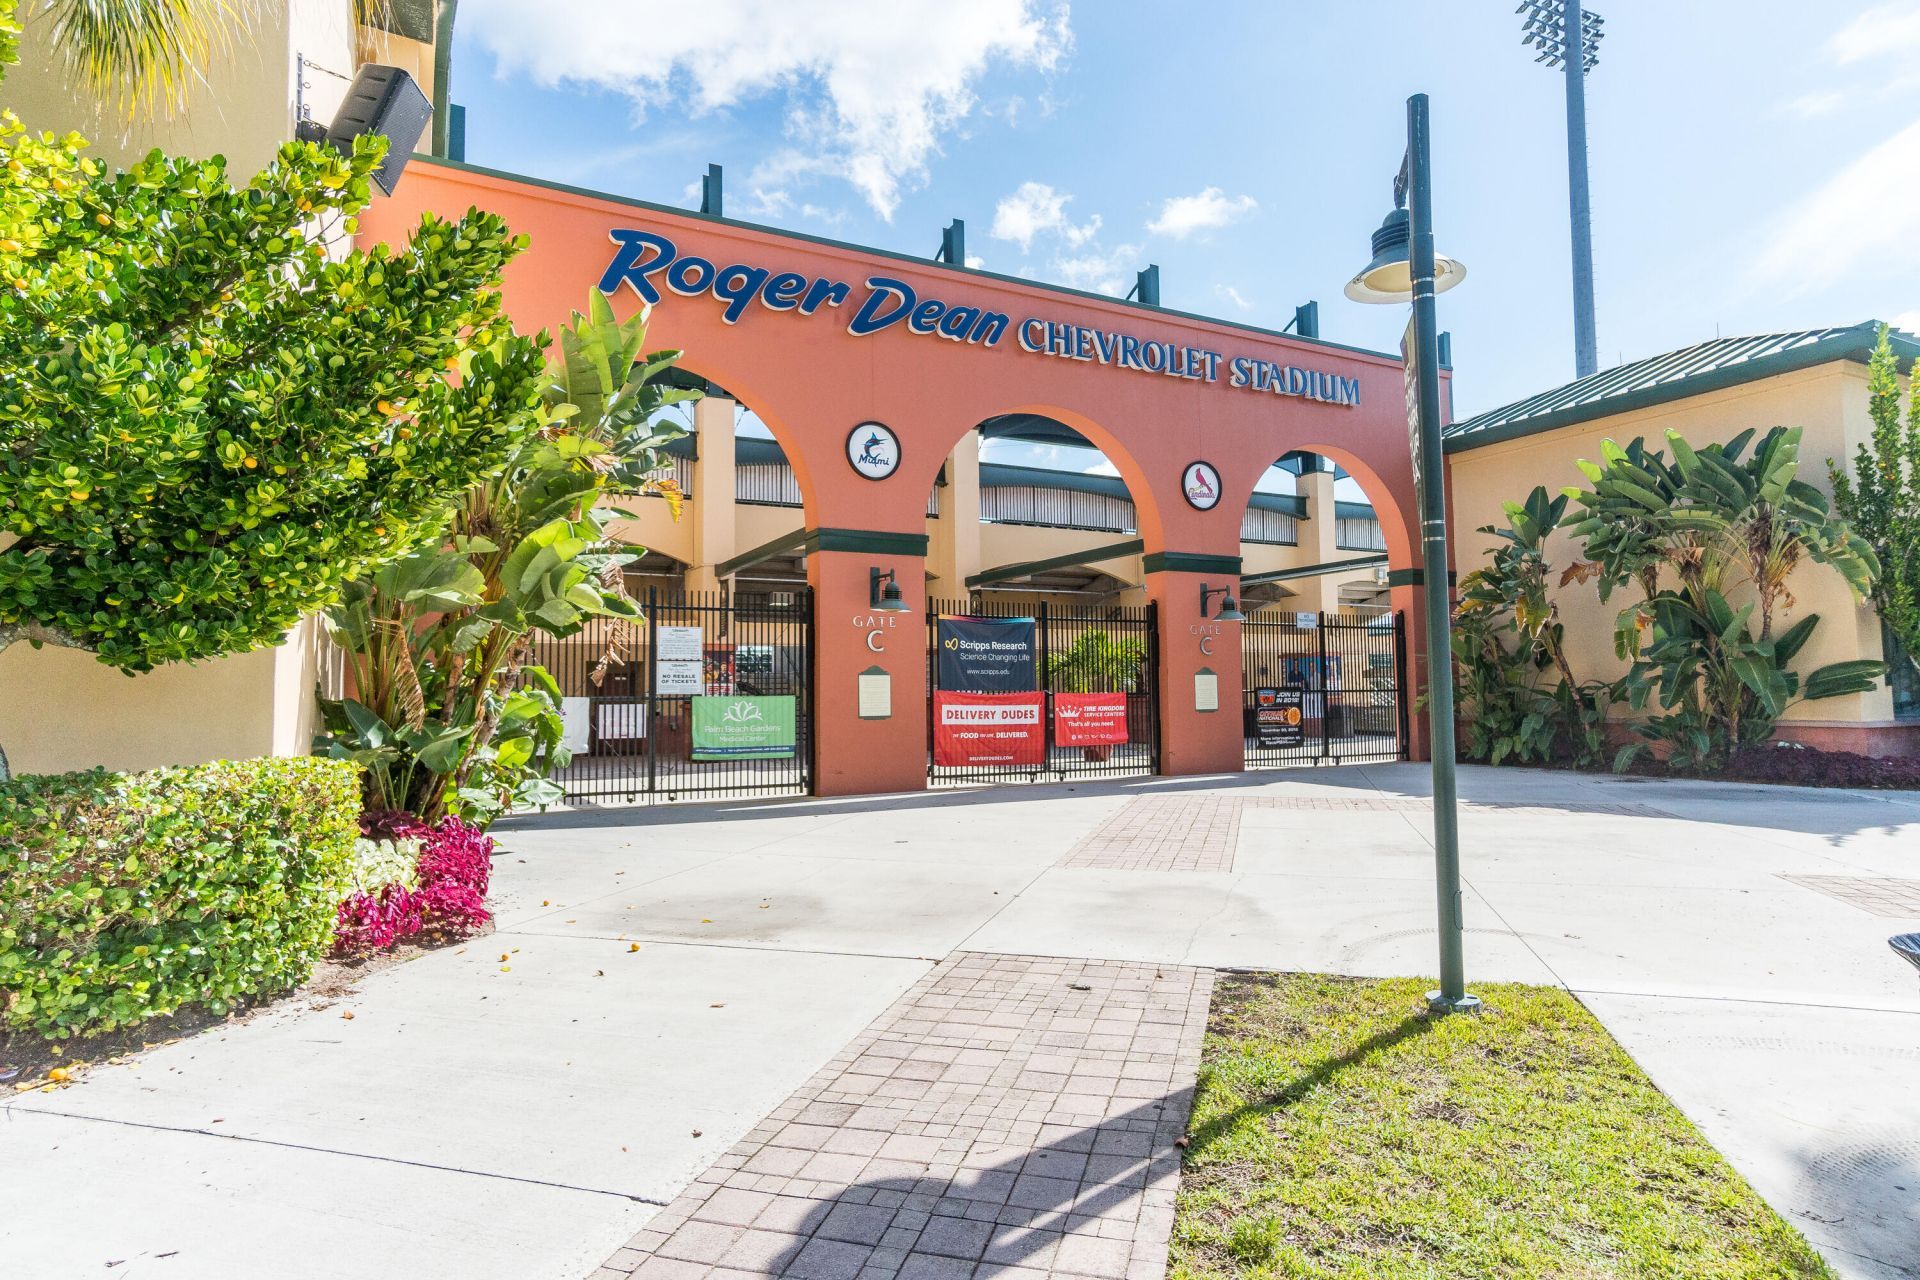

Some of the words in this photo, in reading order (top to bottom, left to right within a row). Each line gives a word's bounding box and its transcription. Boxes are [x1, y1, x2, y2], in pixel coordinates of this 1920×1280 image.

[599, 228, 852, 326] Roger
[847, 276, 1010, 347] Dean
[1017, 318, 1222, 382] CHEVROLET
[1229, 357, 1361, 408] STADIUM
[857, 454, 890, 468] Miami
[852, 615, 897, 628] GATE
[1189, 624, 1221, 635] GATE
[866, 629, 885, 653] C
[960, 640, 990, 652] Scripps
[991, 641, 1027, 650] Research
[1200, 635, 1214, 656] C
[960, 653, 987, 661] Science
[988, 653, 1018, 663] Changing
[1018, 654, 1030, 662] Life
[946, 710, 996, 720] DELIVERY
[1001, 710, 1035, 719] DUDES
[750, 724, 781, 732] Gardens
